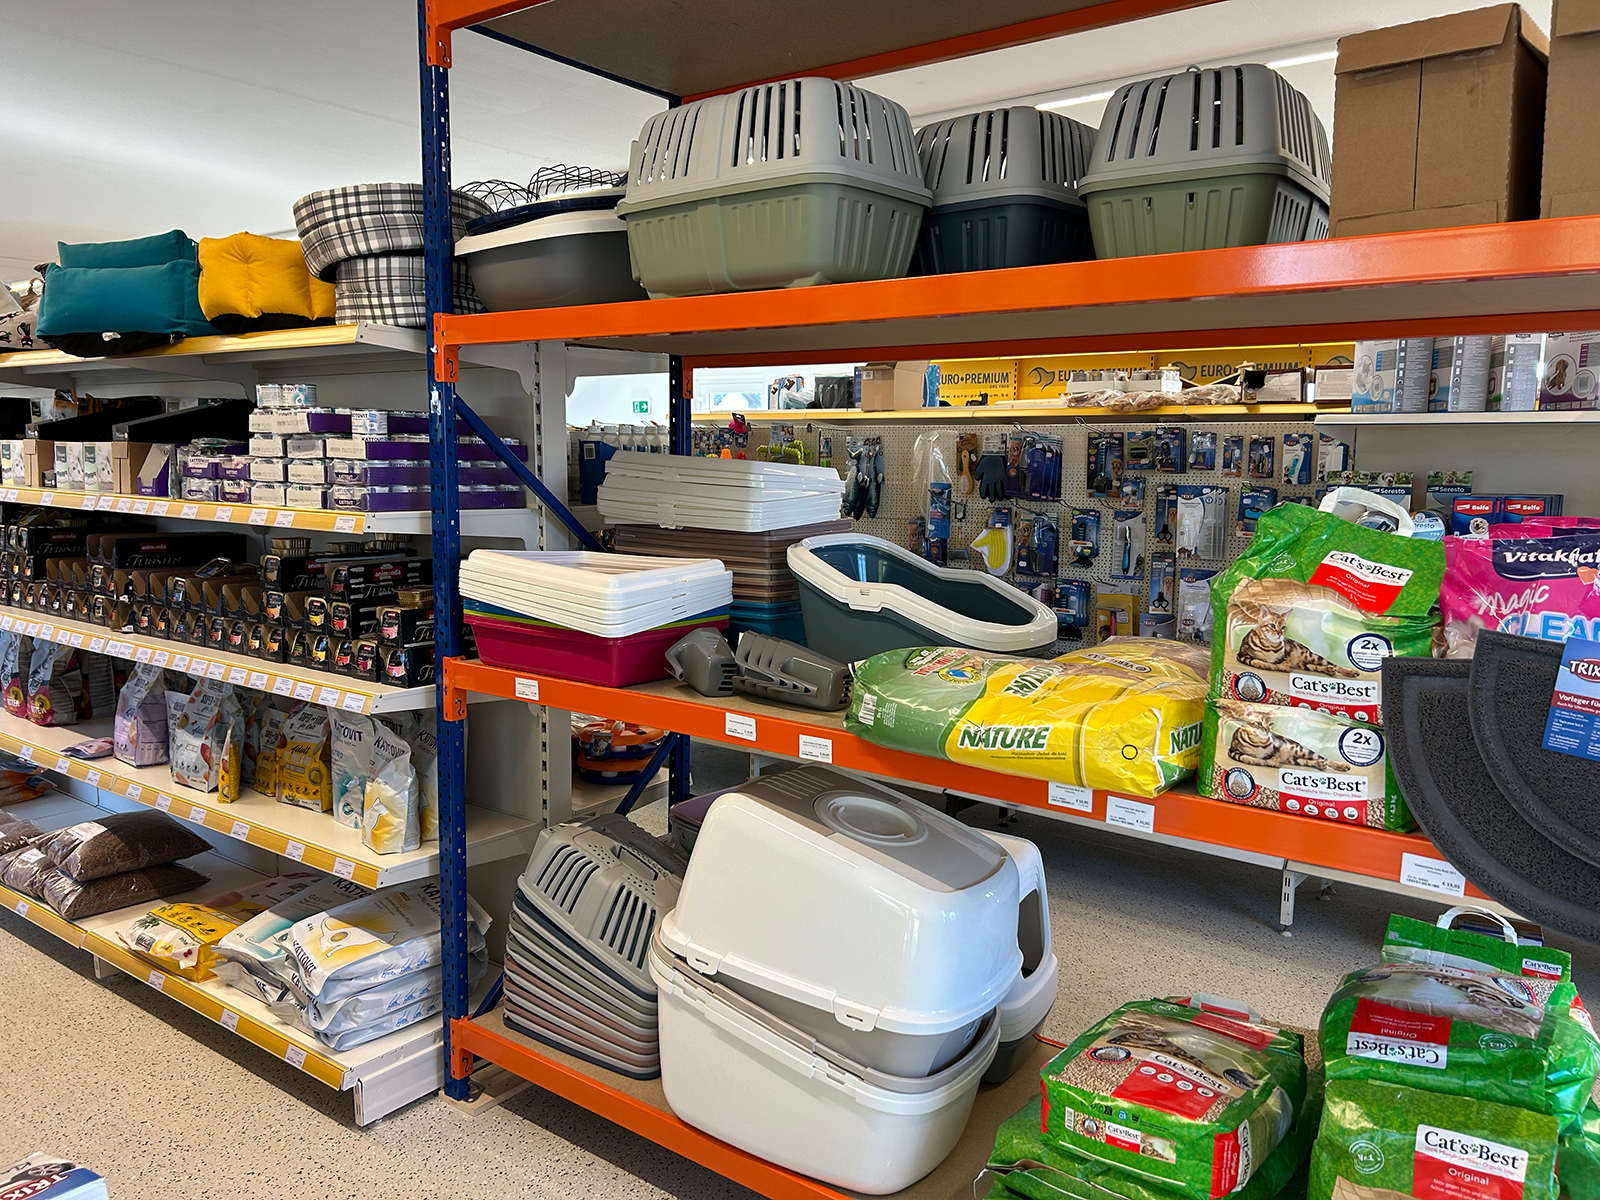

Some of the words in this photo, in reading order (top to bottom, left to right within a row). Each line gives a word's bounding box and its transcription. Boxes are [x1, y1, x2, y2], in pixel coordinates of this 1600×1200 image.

[964, 372, 1010, 384] PREMIUM
[1200, 364, 1230, 378] EURO
[1414, 522, 1436, 530] eresto
[1346, 573, 1370, 588] Original
[1474, 584, 1550, 616] Magic
[1361, 638, 1380, 652] 2x
[1570, 660, 1600, 678] TRIX
[1292, 676, 1329, 693] Cat's
[1336, 682, 1372, 698] Best
[1559, 694, 1590, 706] Vorleger
[958, 726, 1052, 750] NATURE
[1170, 720, 1204, 755] NATU
[1353, 732, 1372, 746] 2x
[1282, 772, 1319, 788] Cat's
[1326, 776, 1362, 792] Best
[1308, 798, 1336, 807] Original
[1380, 1028, 1417, 1038] Original
[1354, 1040, 1389, 1056] Best
[1396, 1045, 1439, 1064] Cat's
[1154, 1054, 1188, 1071] Cat's
[1194, 1068, 1225, 1090] Best
[1424, 1130, 1469, 1154] Cat's
[1478, 1144, 1519, 1170] Best
[1448, 1168, 1489, 1186] Original
[0, 1174, 70, 1200] TRIX
[1430, 1184, 1444, 1192] Active
